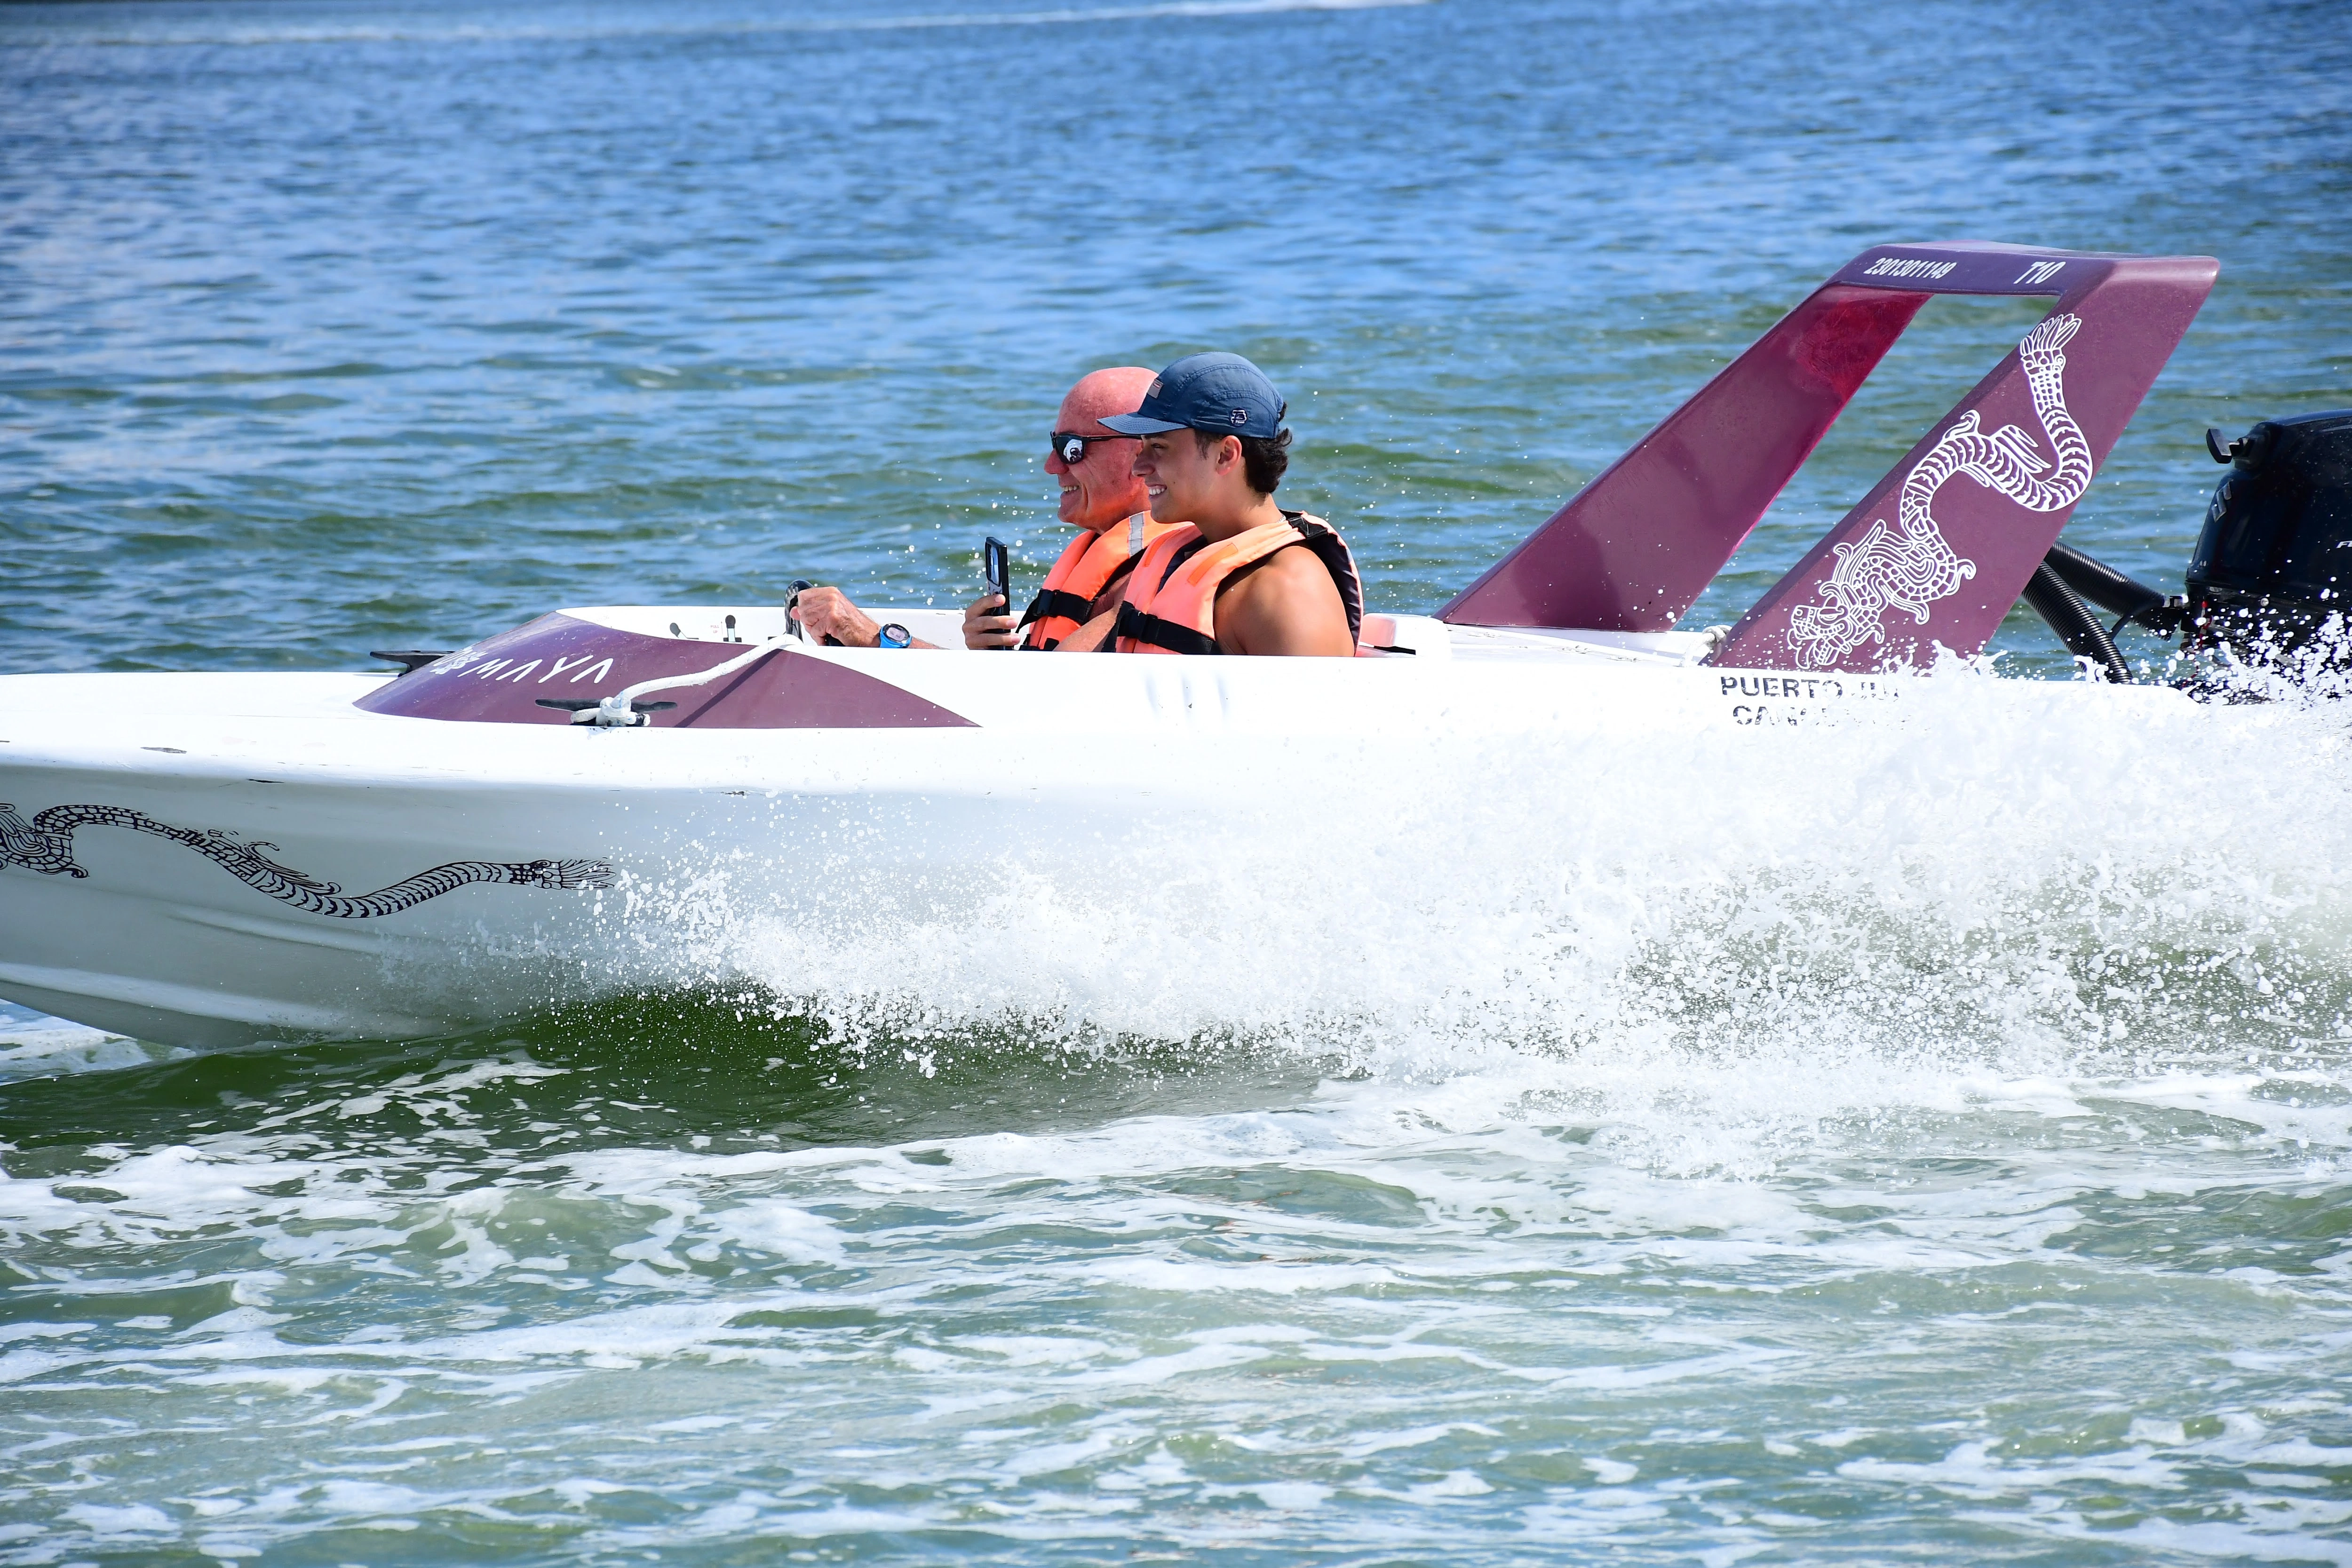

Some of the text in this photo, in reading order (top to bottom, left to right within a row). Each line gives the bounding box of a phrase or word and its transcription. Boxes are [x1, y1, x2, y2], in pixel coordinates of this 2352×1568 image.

[1863, 257, 2066, 284] 23013011149 T10
[457, 655, 614, 684] MAYA
[1720, 676, 1843, 699] PUERTO
